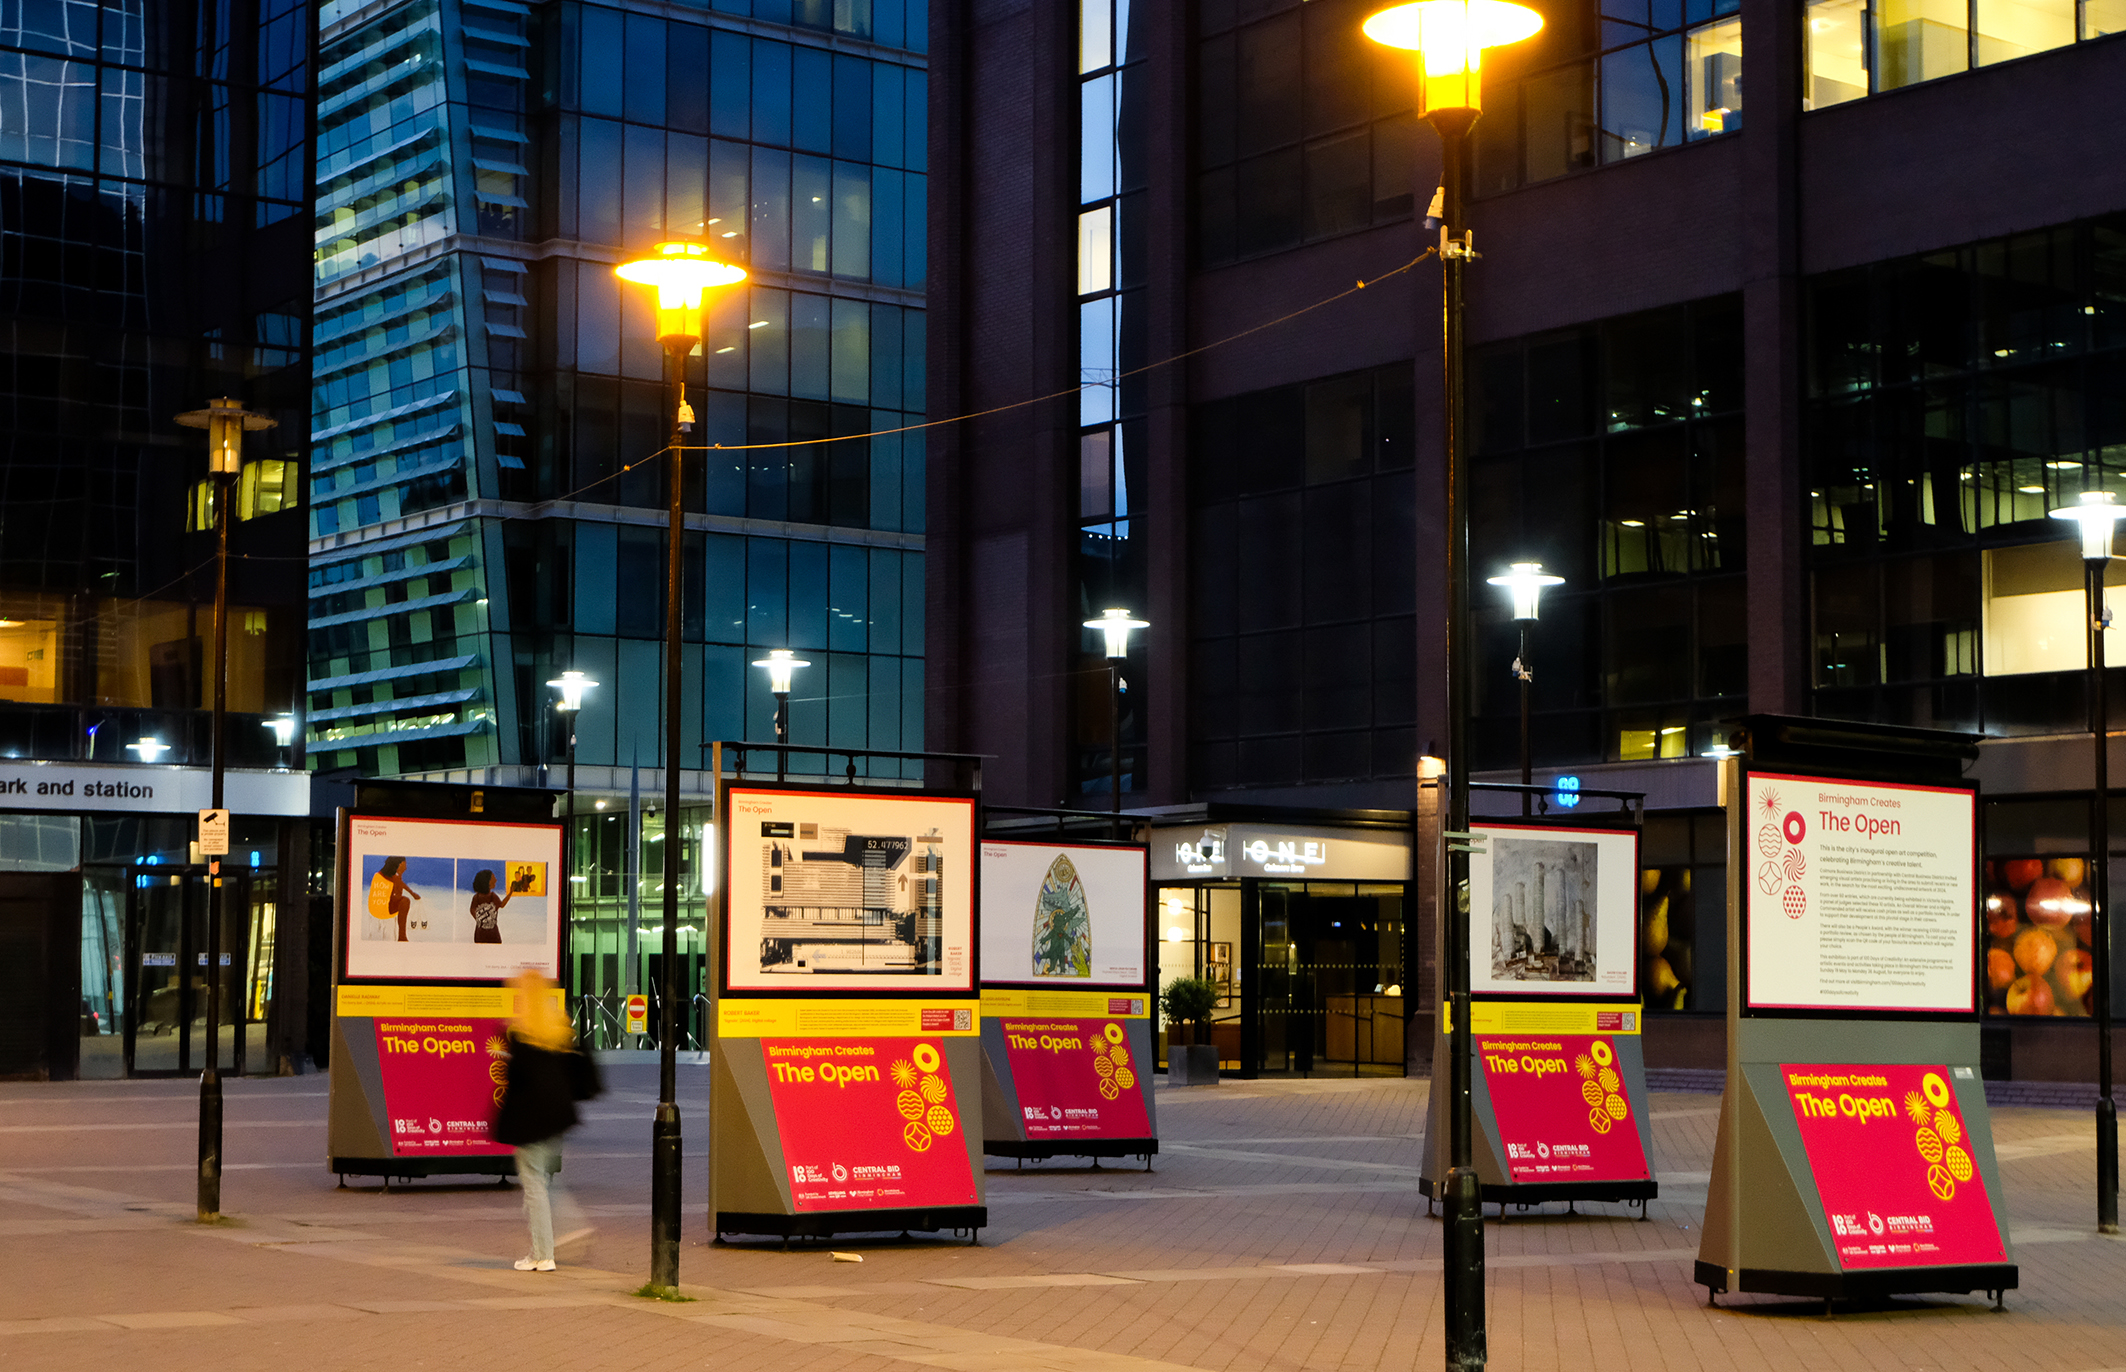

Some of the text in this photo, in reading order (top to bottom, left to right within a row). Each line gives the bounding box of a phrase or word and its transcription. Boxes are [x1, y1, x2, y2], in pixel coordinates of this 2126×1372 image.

[37, 780, 74, 796] and
[84, 780, 154, 798] station
[1819, 793, 1901, 808] Birmingham Creates
[753, 806, 772, 815] Open
[1819, 811, 1900, 840] The Open
[1846, 846, 1859, 854] city's
[1860, 847, 1884, 856] inaugural
[381, 1023, 472, 1034] Birmingham Creates
[1005, 1022, 1050, 1032] Birmingham
[383, 1036, 475, 1059] The Open
[1008, 1034, 1082, 1054] The Open
[1482, 1041, 1562, 1053] Birmingham Creates
[769, 1046, 874, 1059] Birmingham Creates
[1485, 1055, 1568, 1078] The Open
[772, 1062, 880, 1088] The Open
[1789, 1073, 1888, 1089] Birmingham Creates
[1795, 1092, 1897, 1125] The Open
[1887, 1216, 1931, 1224] CENTRAL BID
